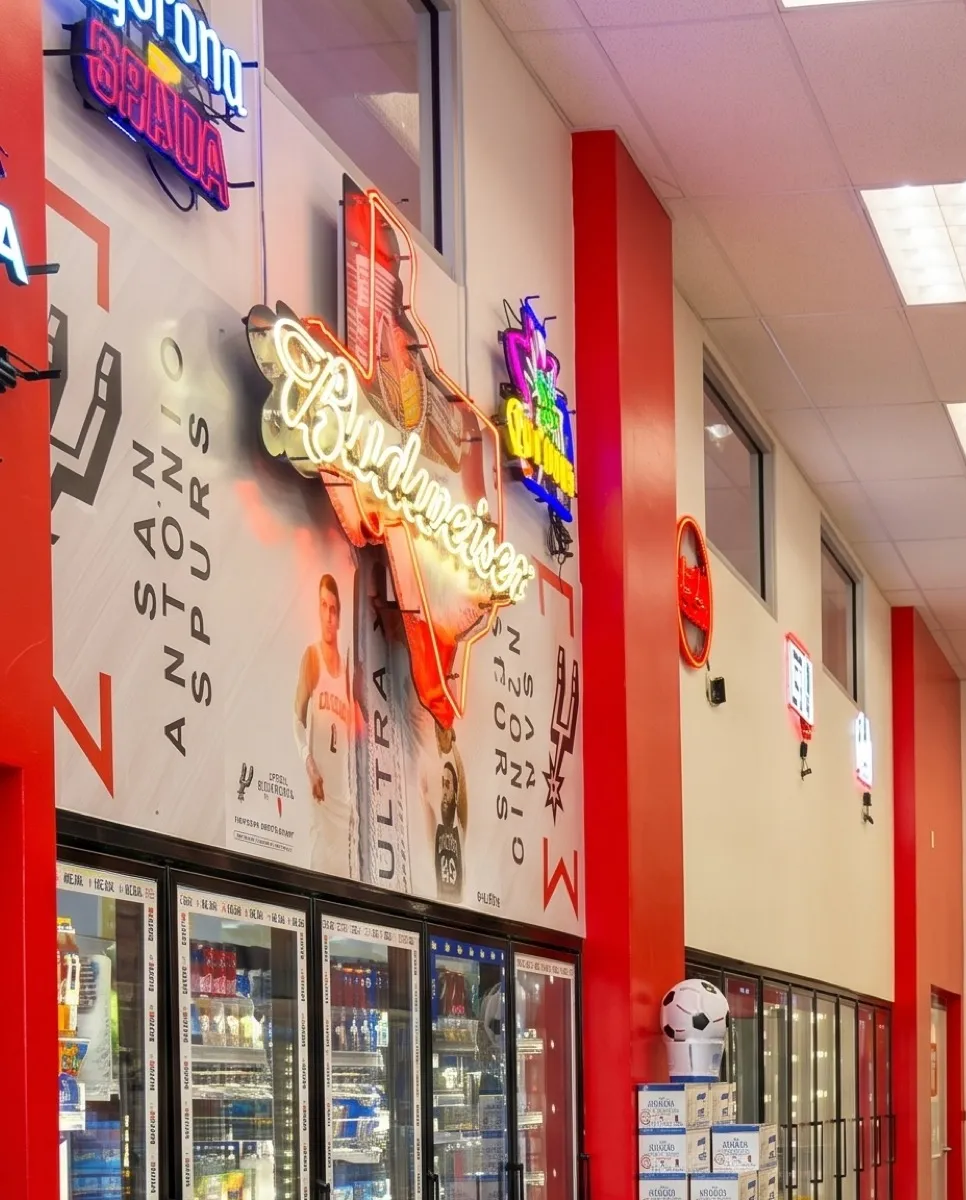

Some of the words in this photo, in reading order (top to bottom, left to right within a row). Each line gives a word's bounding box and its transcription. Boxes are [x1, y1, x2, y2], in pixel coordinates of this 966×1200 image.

[132, 439, 157, 621] SAN
[160, 336, 187, 758] ANTONIO
[188, 413, 213, 708] SPURS
[373, 666, 395, 880] ULTRA
